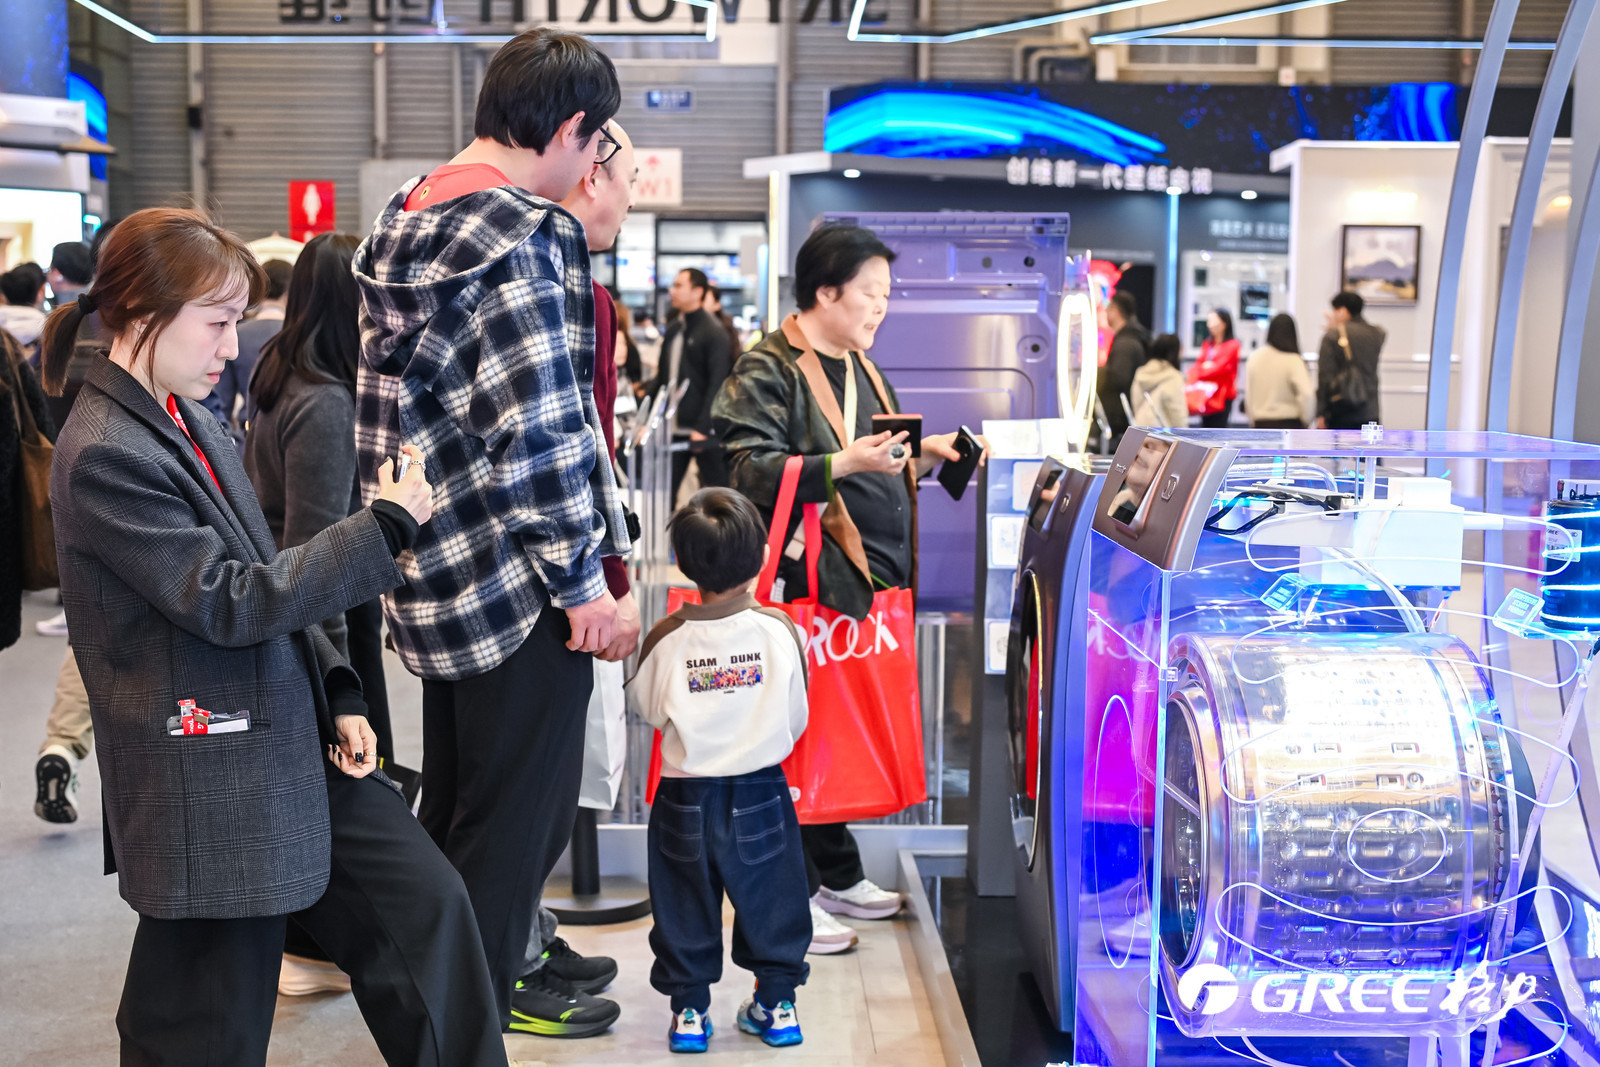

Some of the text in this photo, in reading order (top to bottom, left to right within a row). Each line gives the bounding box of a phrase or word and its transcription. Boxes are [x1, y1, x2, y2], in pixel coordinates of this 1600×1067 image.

[686, 652, 761, 669] SLAM DUNK
[1251, 957, 1537, 1021] GREE 格力
